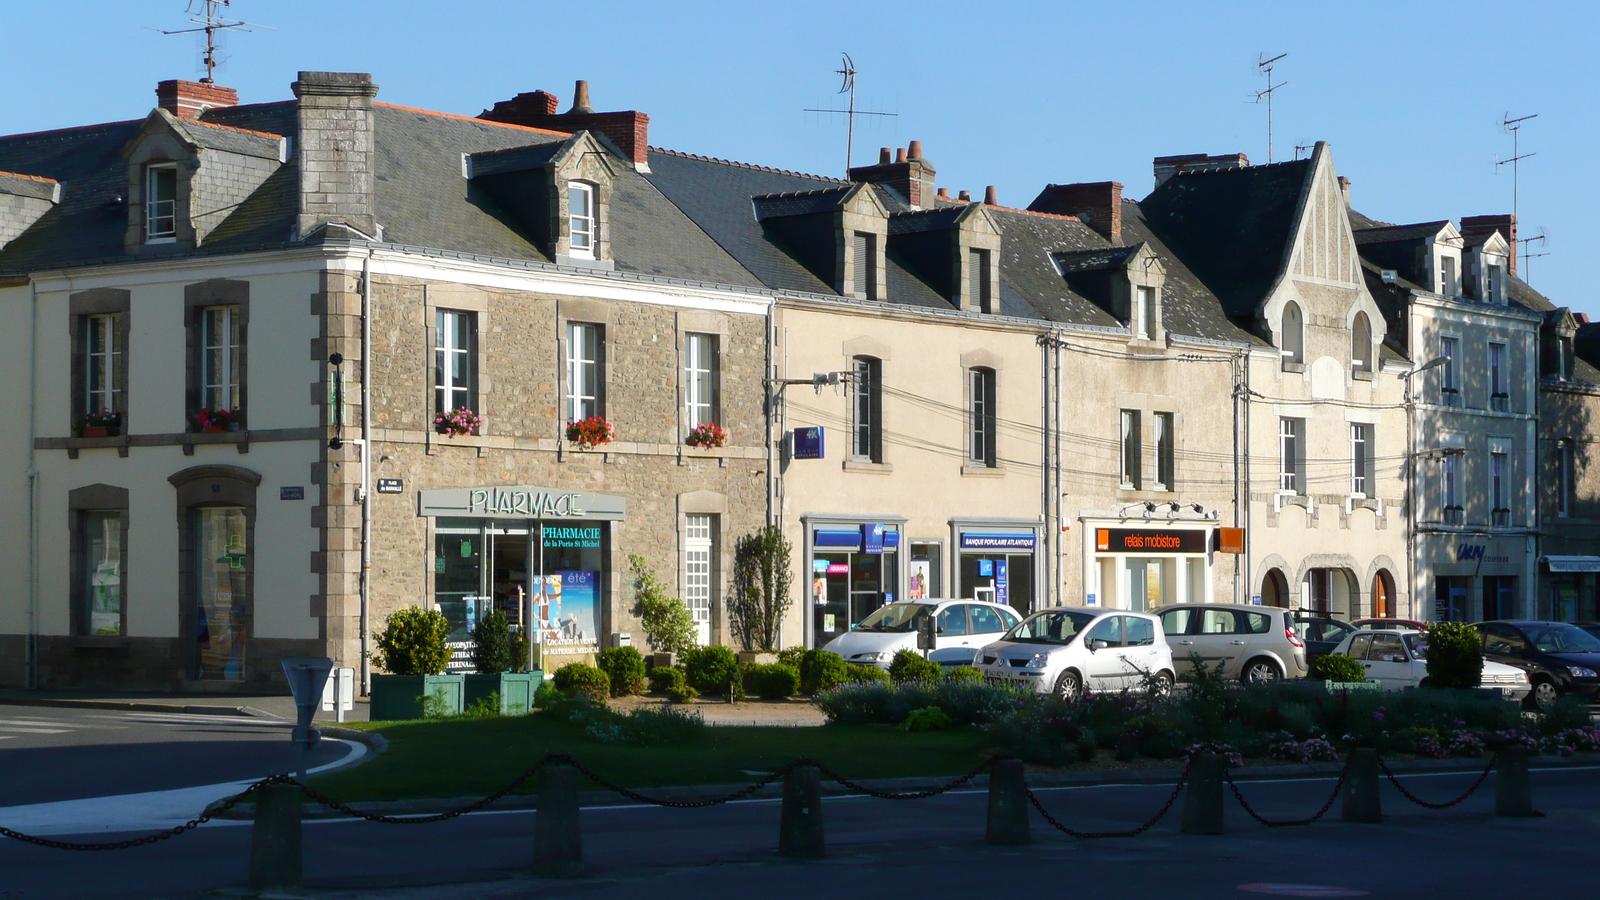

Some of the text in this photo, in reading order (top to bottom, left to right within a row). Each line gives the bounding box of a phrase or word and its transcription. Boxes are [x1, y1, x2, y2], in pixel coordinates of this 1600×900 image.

[470, 487, 586, 517] PHARMACIE
[542, 527, 600, 539] PHARMACIE
[558, 540, 574, 548] Porte
[574, 540, 581, 548] St
[581, 540, 600, 548] Michel
[965, 538, 984, 546] BANQUE
[984, 538, 1007, 546] POPULAIRE
[1124, 533, 1181, 548] relais mobistore
[568, 572, 586, 583] été
